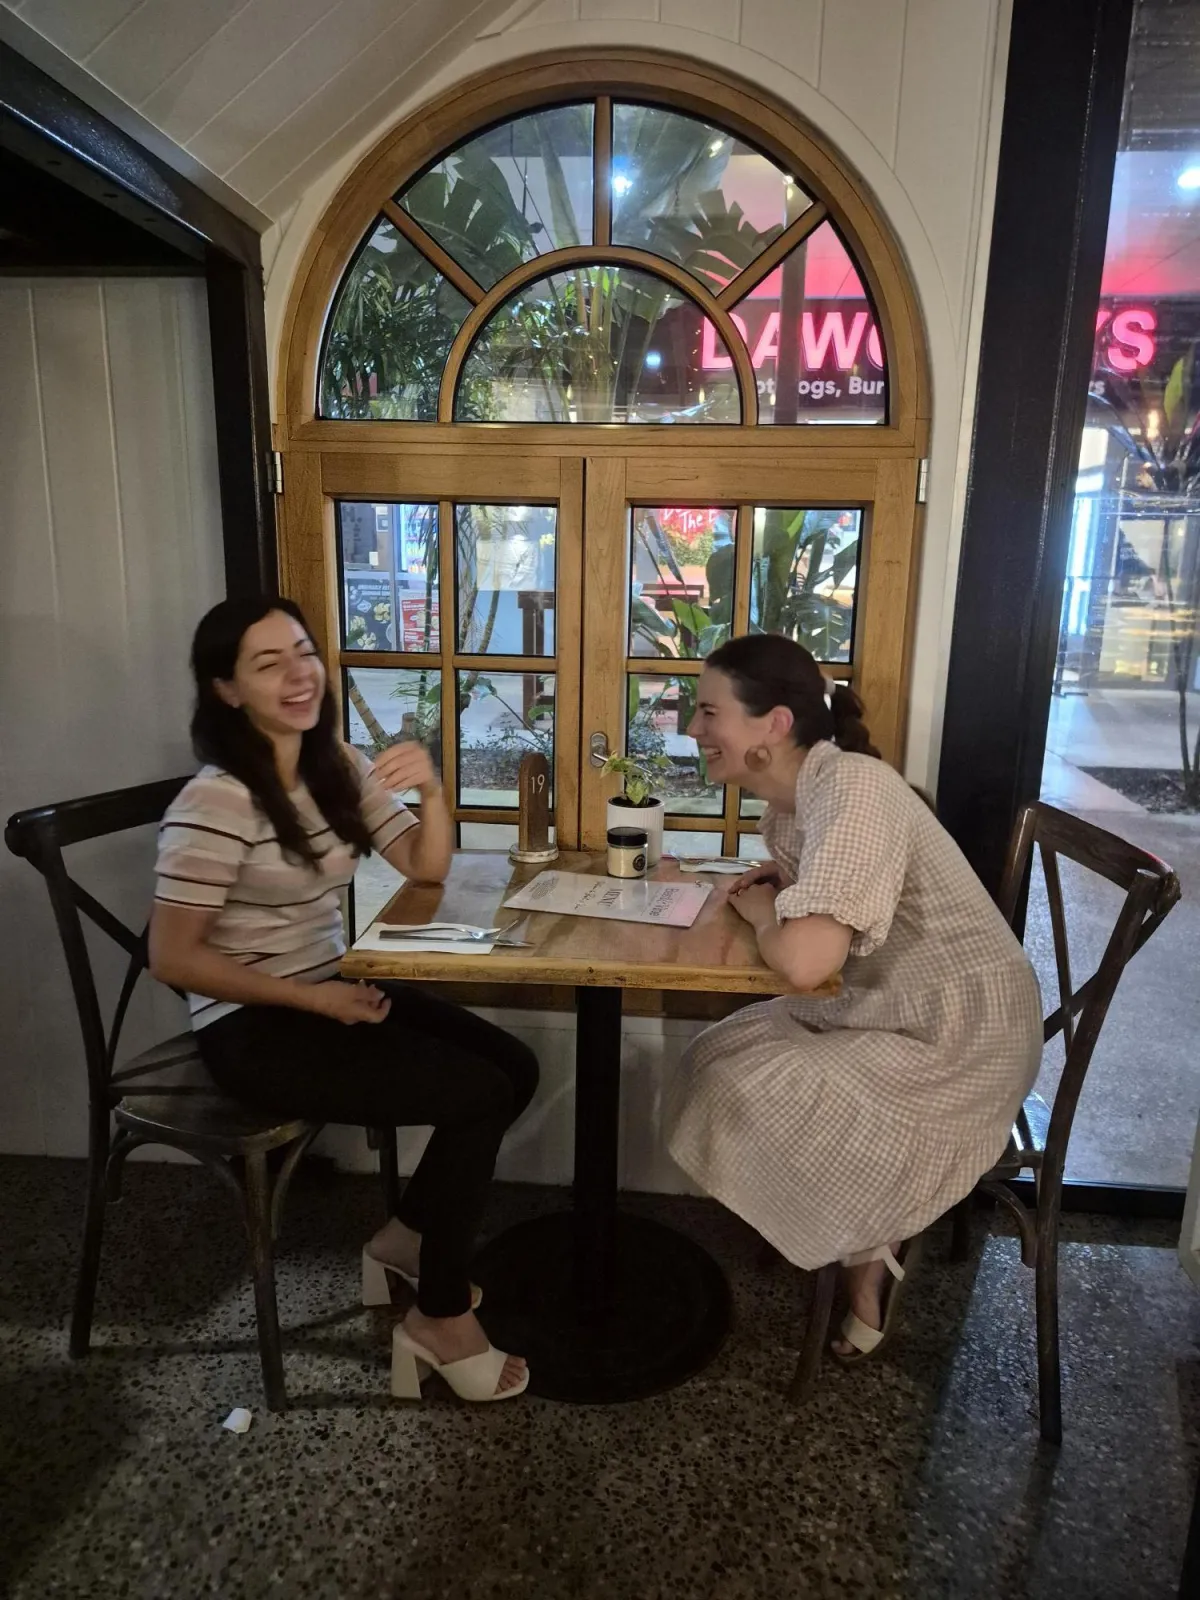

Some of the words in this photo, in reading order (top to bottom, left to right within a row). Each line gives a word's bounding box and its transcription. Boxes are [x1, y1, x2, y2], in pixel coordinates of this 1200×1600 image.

[702, 312, 884, 371] DAW
[798, 379, 842, 400] ogs,
[679, 510, 704, 533] The
[531, 774, 545, 794] 19
